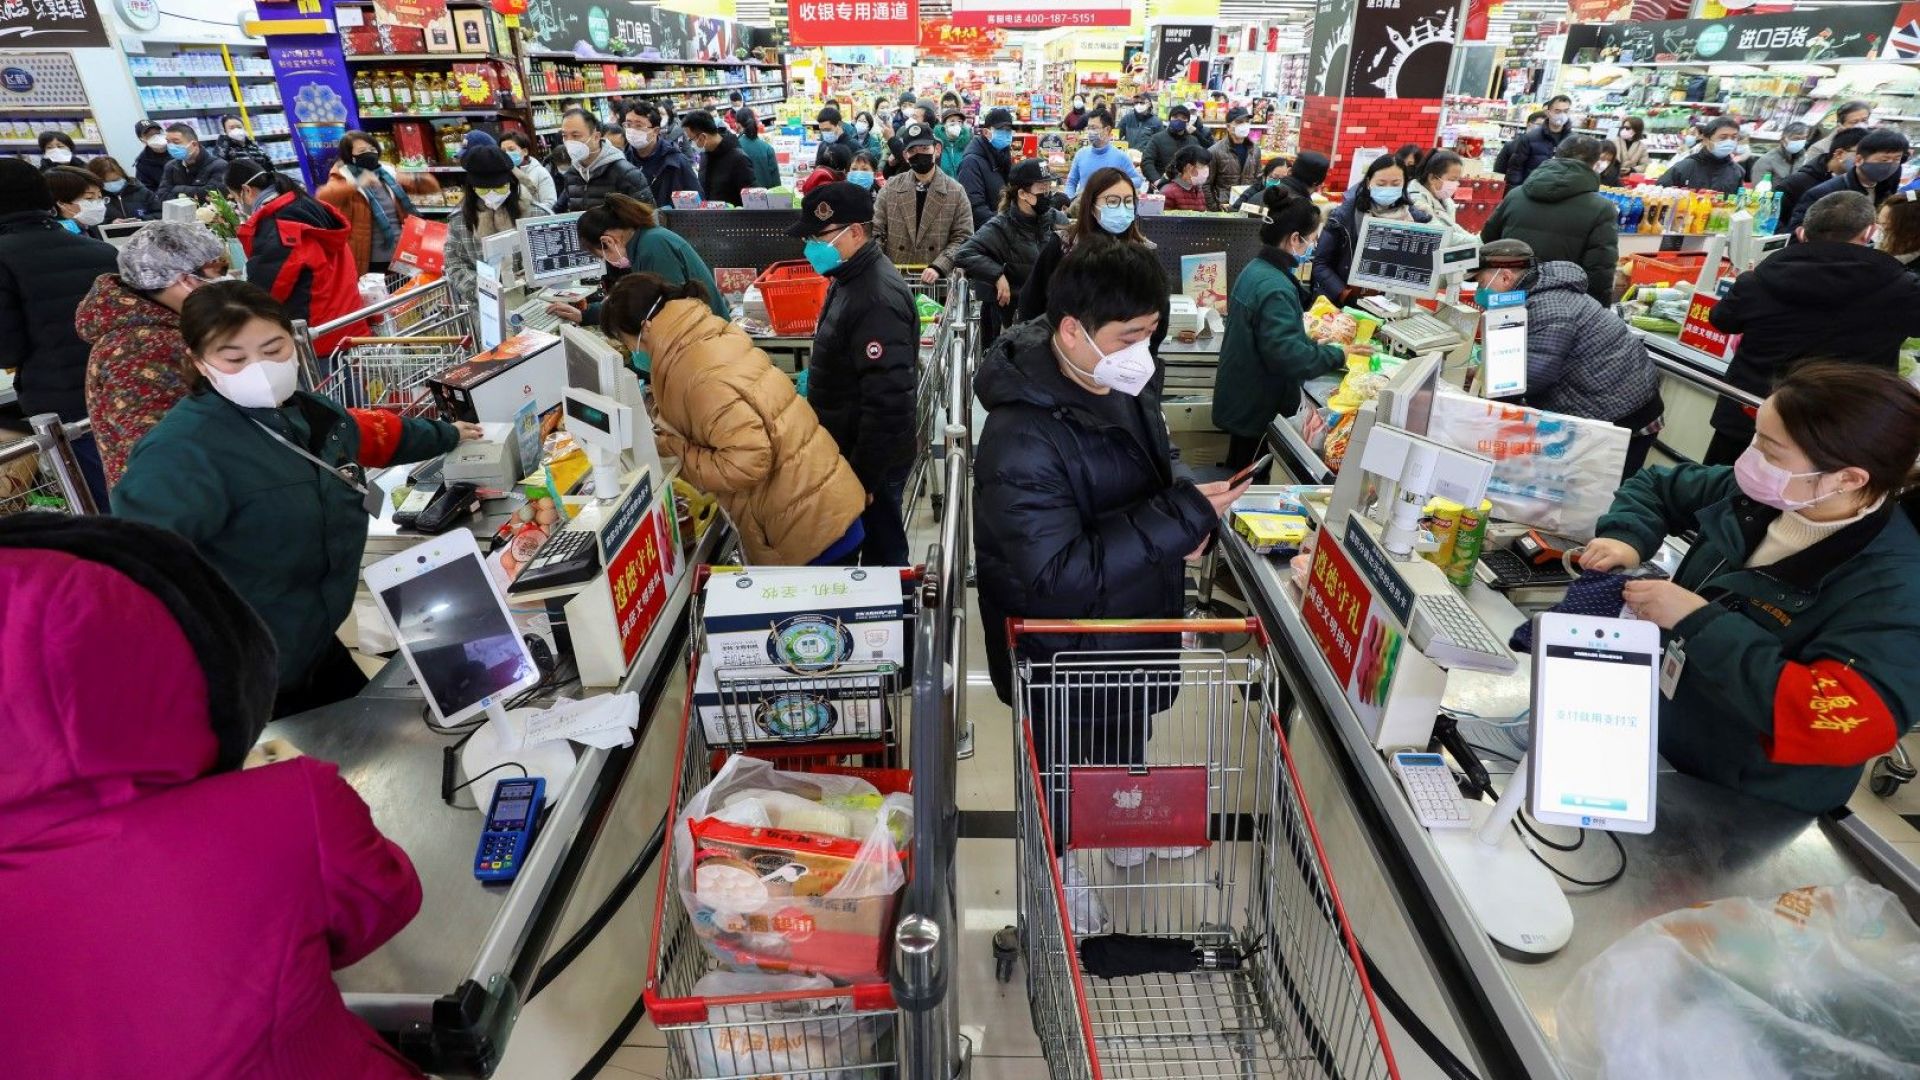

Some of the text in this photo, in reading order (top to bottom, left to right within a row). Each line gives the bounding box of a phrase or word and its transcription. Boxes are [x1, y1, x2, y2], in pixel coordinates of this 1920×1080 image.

[800, 2, 909, 20] 收银专用通道
[1025, 13, 1095, 24] 400-187-5151
[615, 18, 653, 46] 进口食品
[1165, 28, 1192, 37] IMPORT
[1737, 25, 1811, 50] 进口百货
